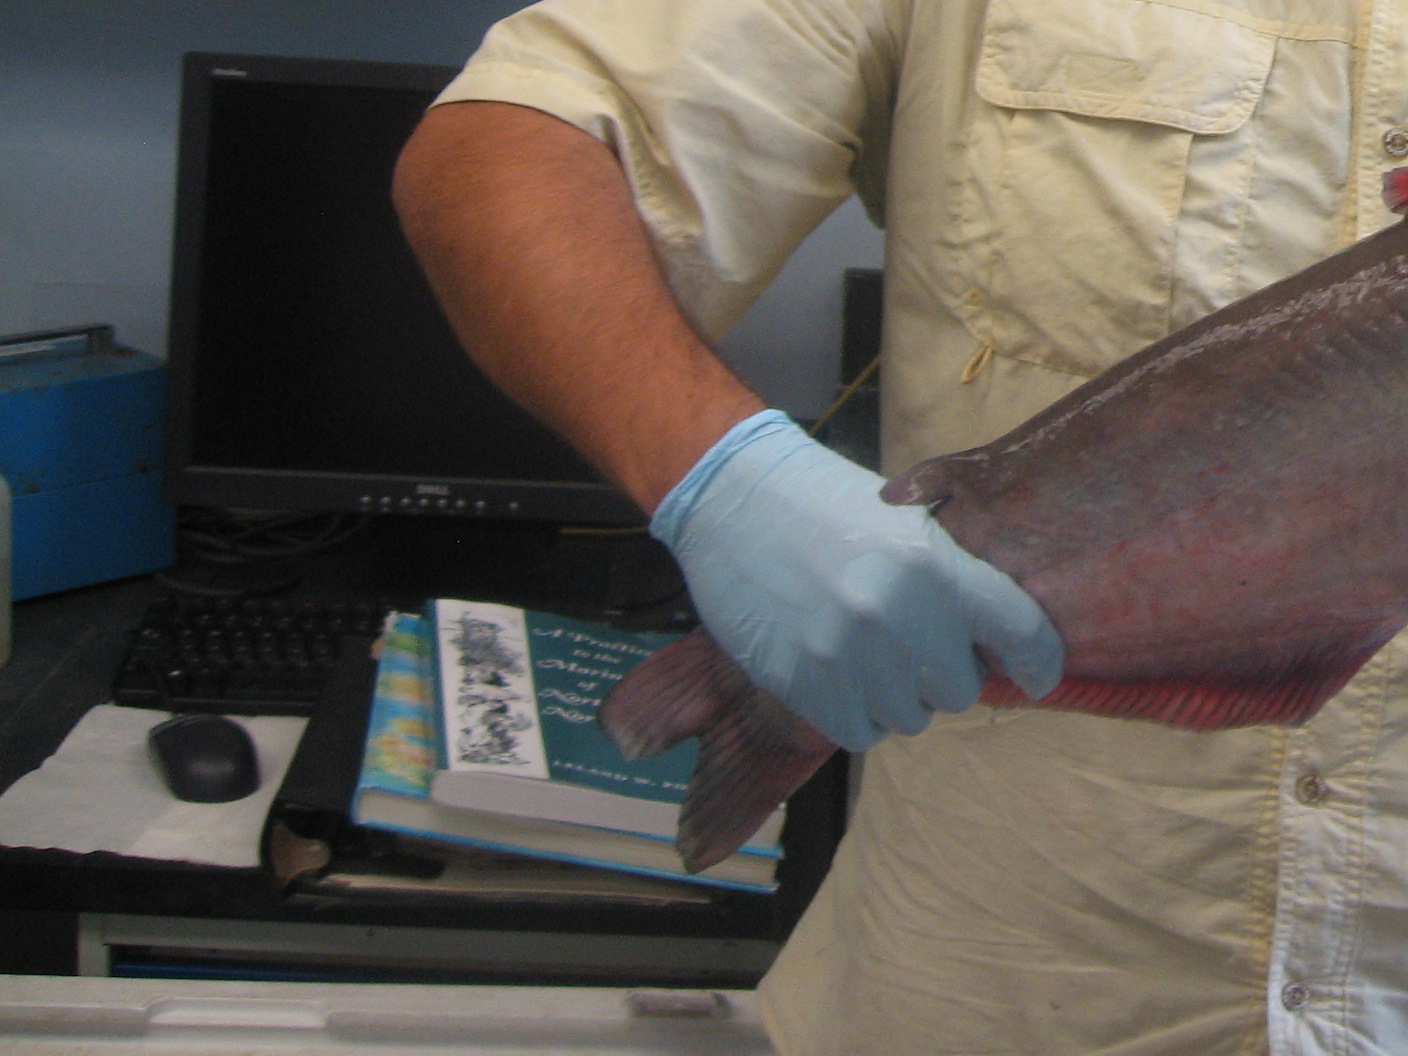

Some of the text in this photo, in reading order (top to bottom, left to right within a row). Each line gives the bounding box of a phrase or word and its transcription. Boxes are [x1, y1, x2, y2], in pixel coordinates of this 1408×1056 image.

[536, 659, 624, 681] Marin
[537, 688, 602, 707] Nort
[541, 706, 597, 724] Nor
